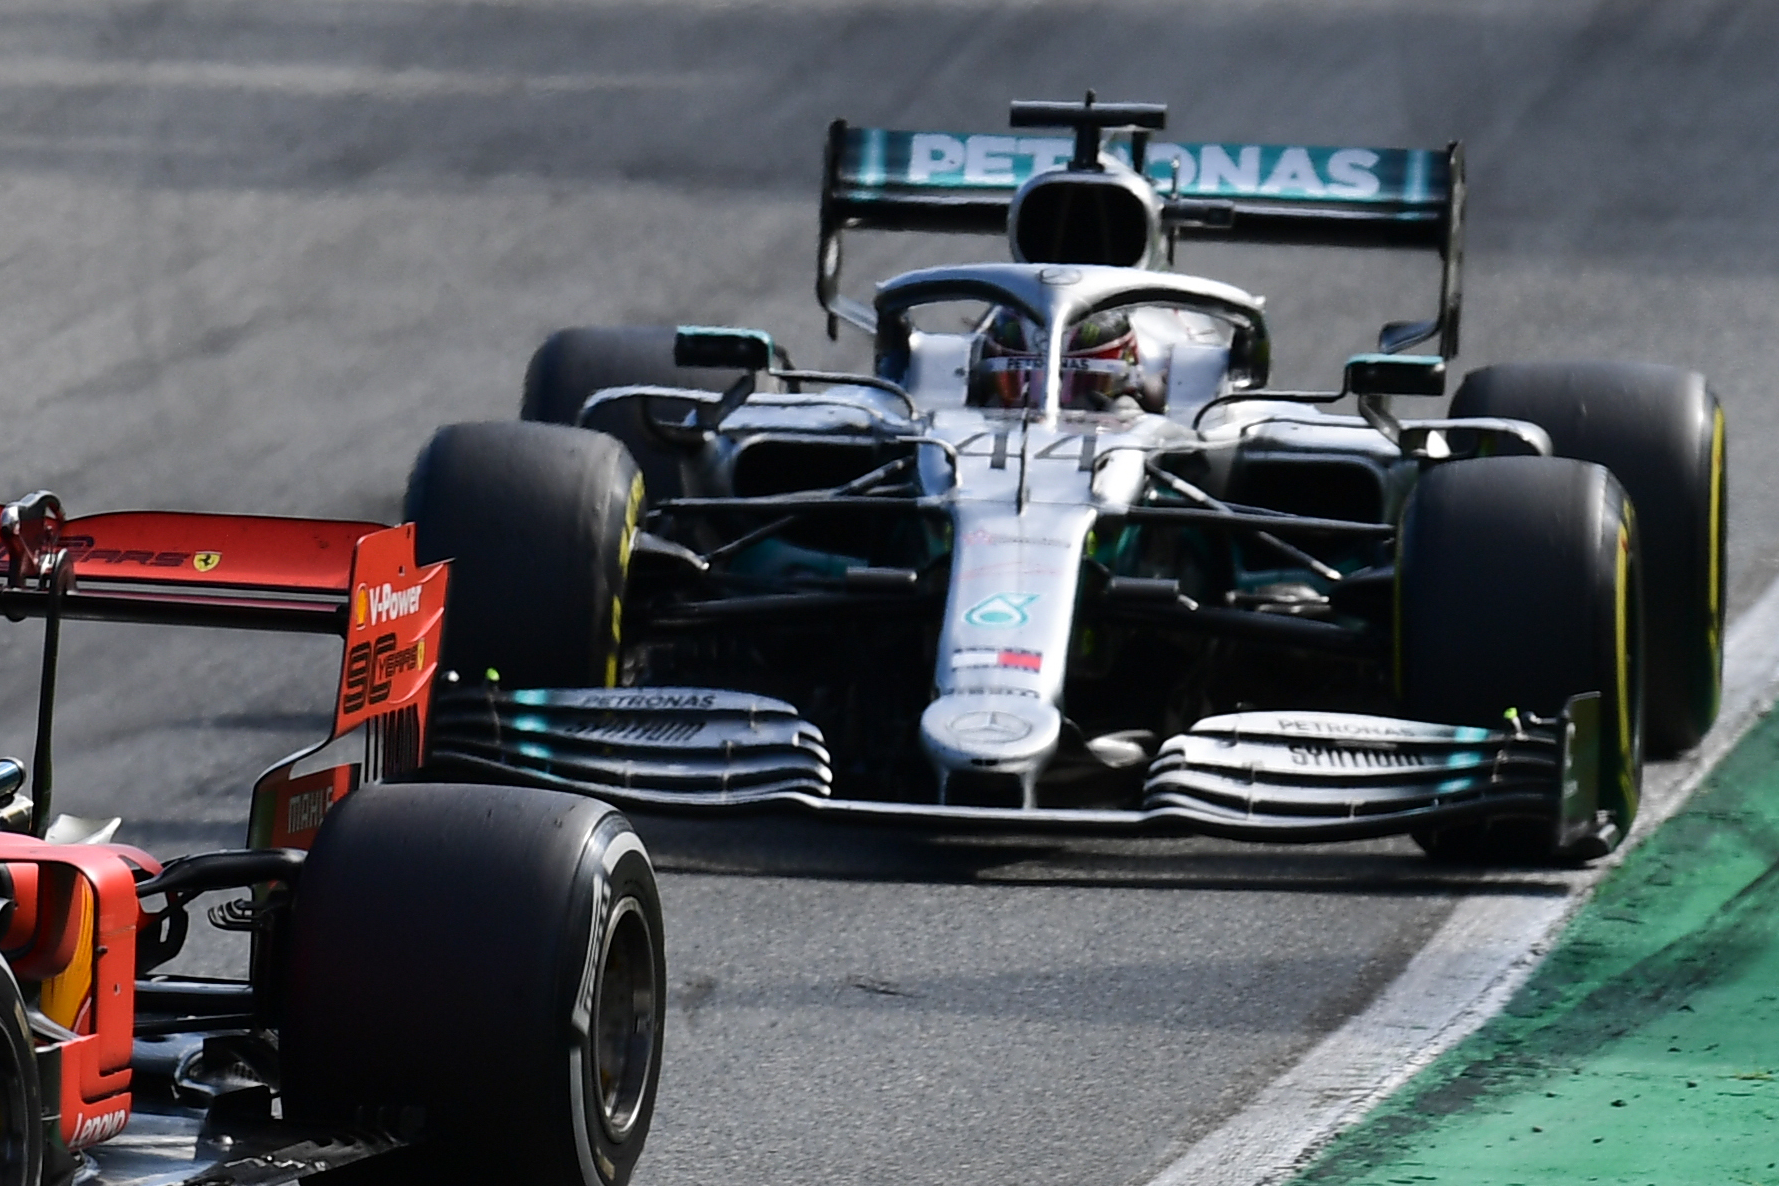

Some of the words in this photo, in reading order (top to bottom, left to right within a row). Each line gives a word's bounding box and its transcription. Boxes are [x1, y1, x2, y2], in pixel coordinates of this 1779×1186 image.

[908, 133, 1382, 198] PETONAS
[955, 432, 1098, 473] 44
[369, 583, 422, 626] V-Power
[68, 1109, 126, 1148] Lenovo
